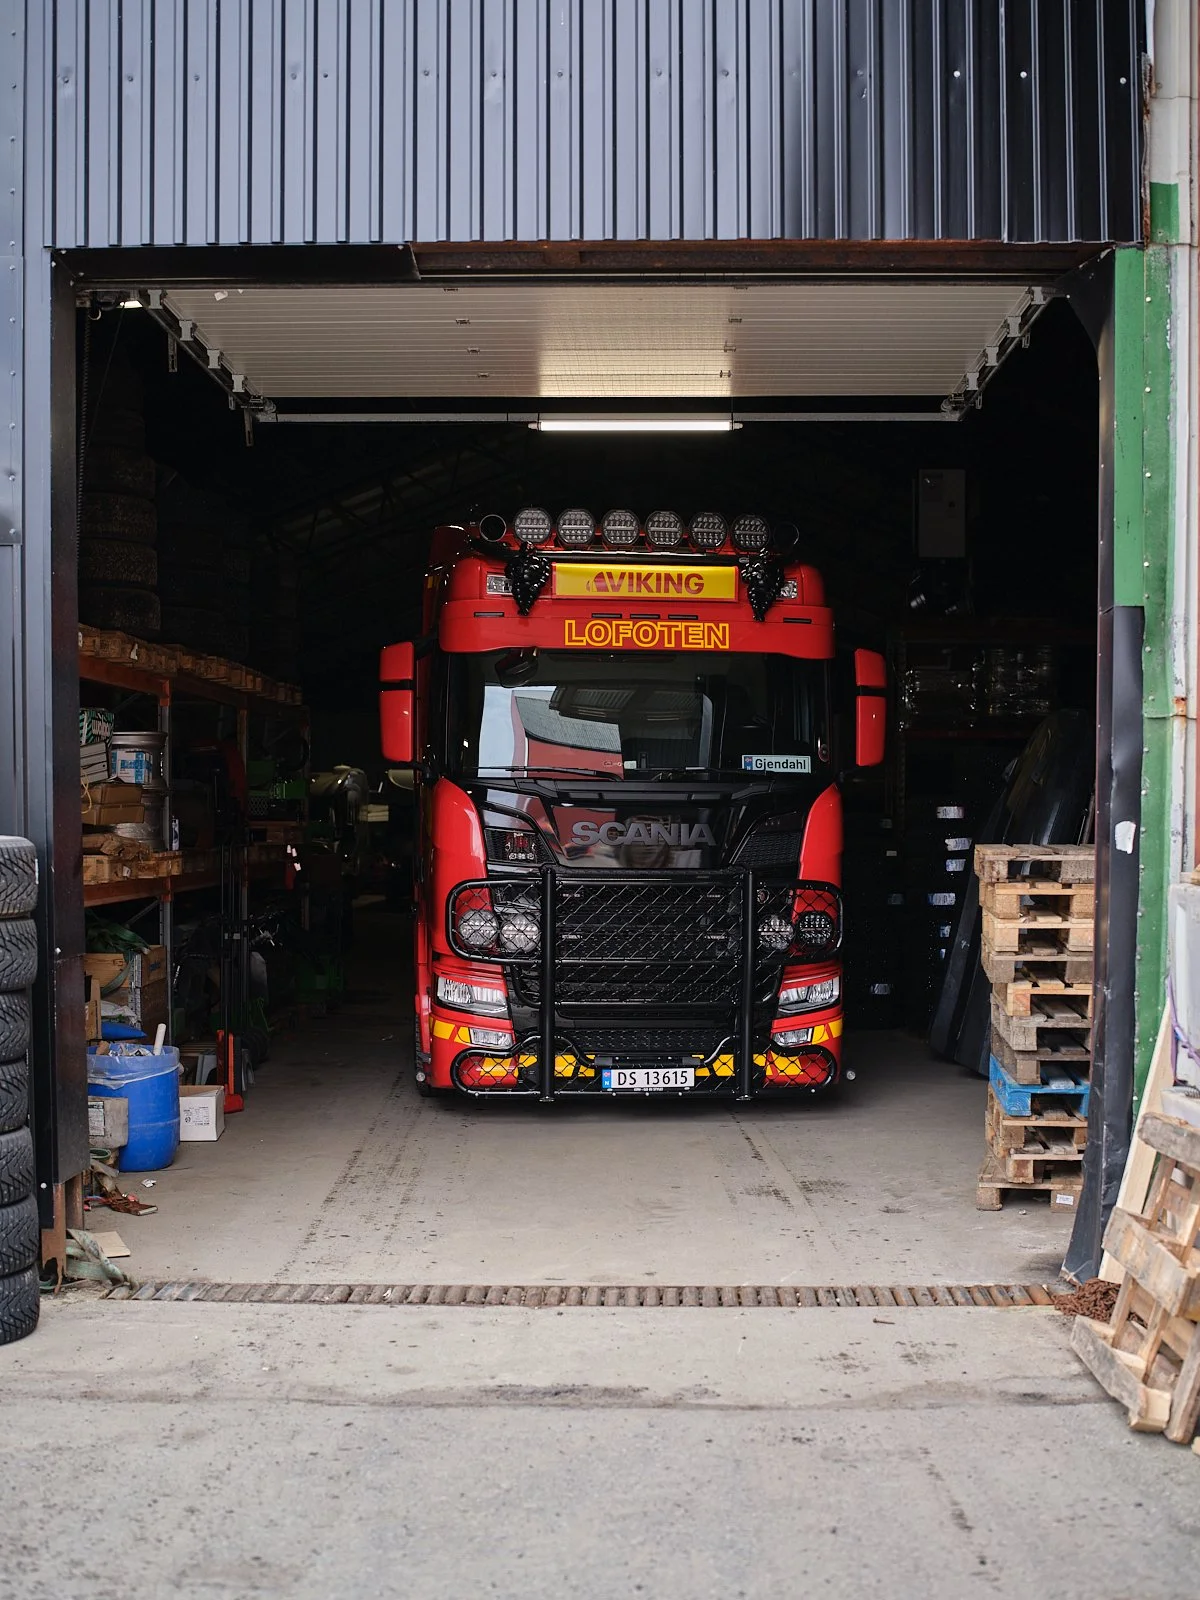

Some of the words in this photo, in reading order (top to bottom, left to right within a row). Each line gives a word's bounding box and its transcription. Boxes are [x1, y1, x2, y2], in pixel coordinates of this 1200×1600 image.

[606, 571, 705, 595] VIKING
[564, 619, 730, 649] LOFOTEN
[755, 758, 806, 771] Gjendahl
[571, 821, 716, 846] SCANIA
[618, 1072, 637, 1086] DS
[644, 1071, 688, 1085] 13615
